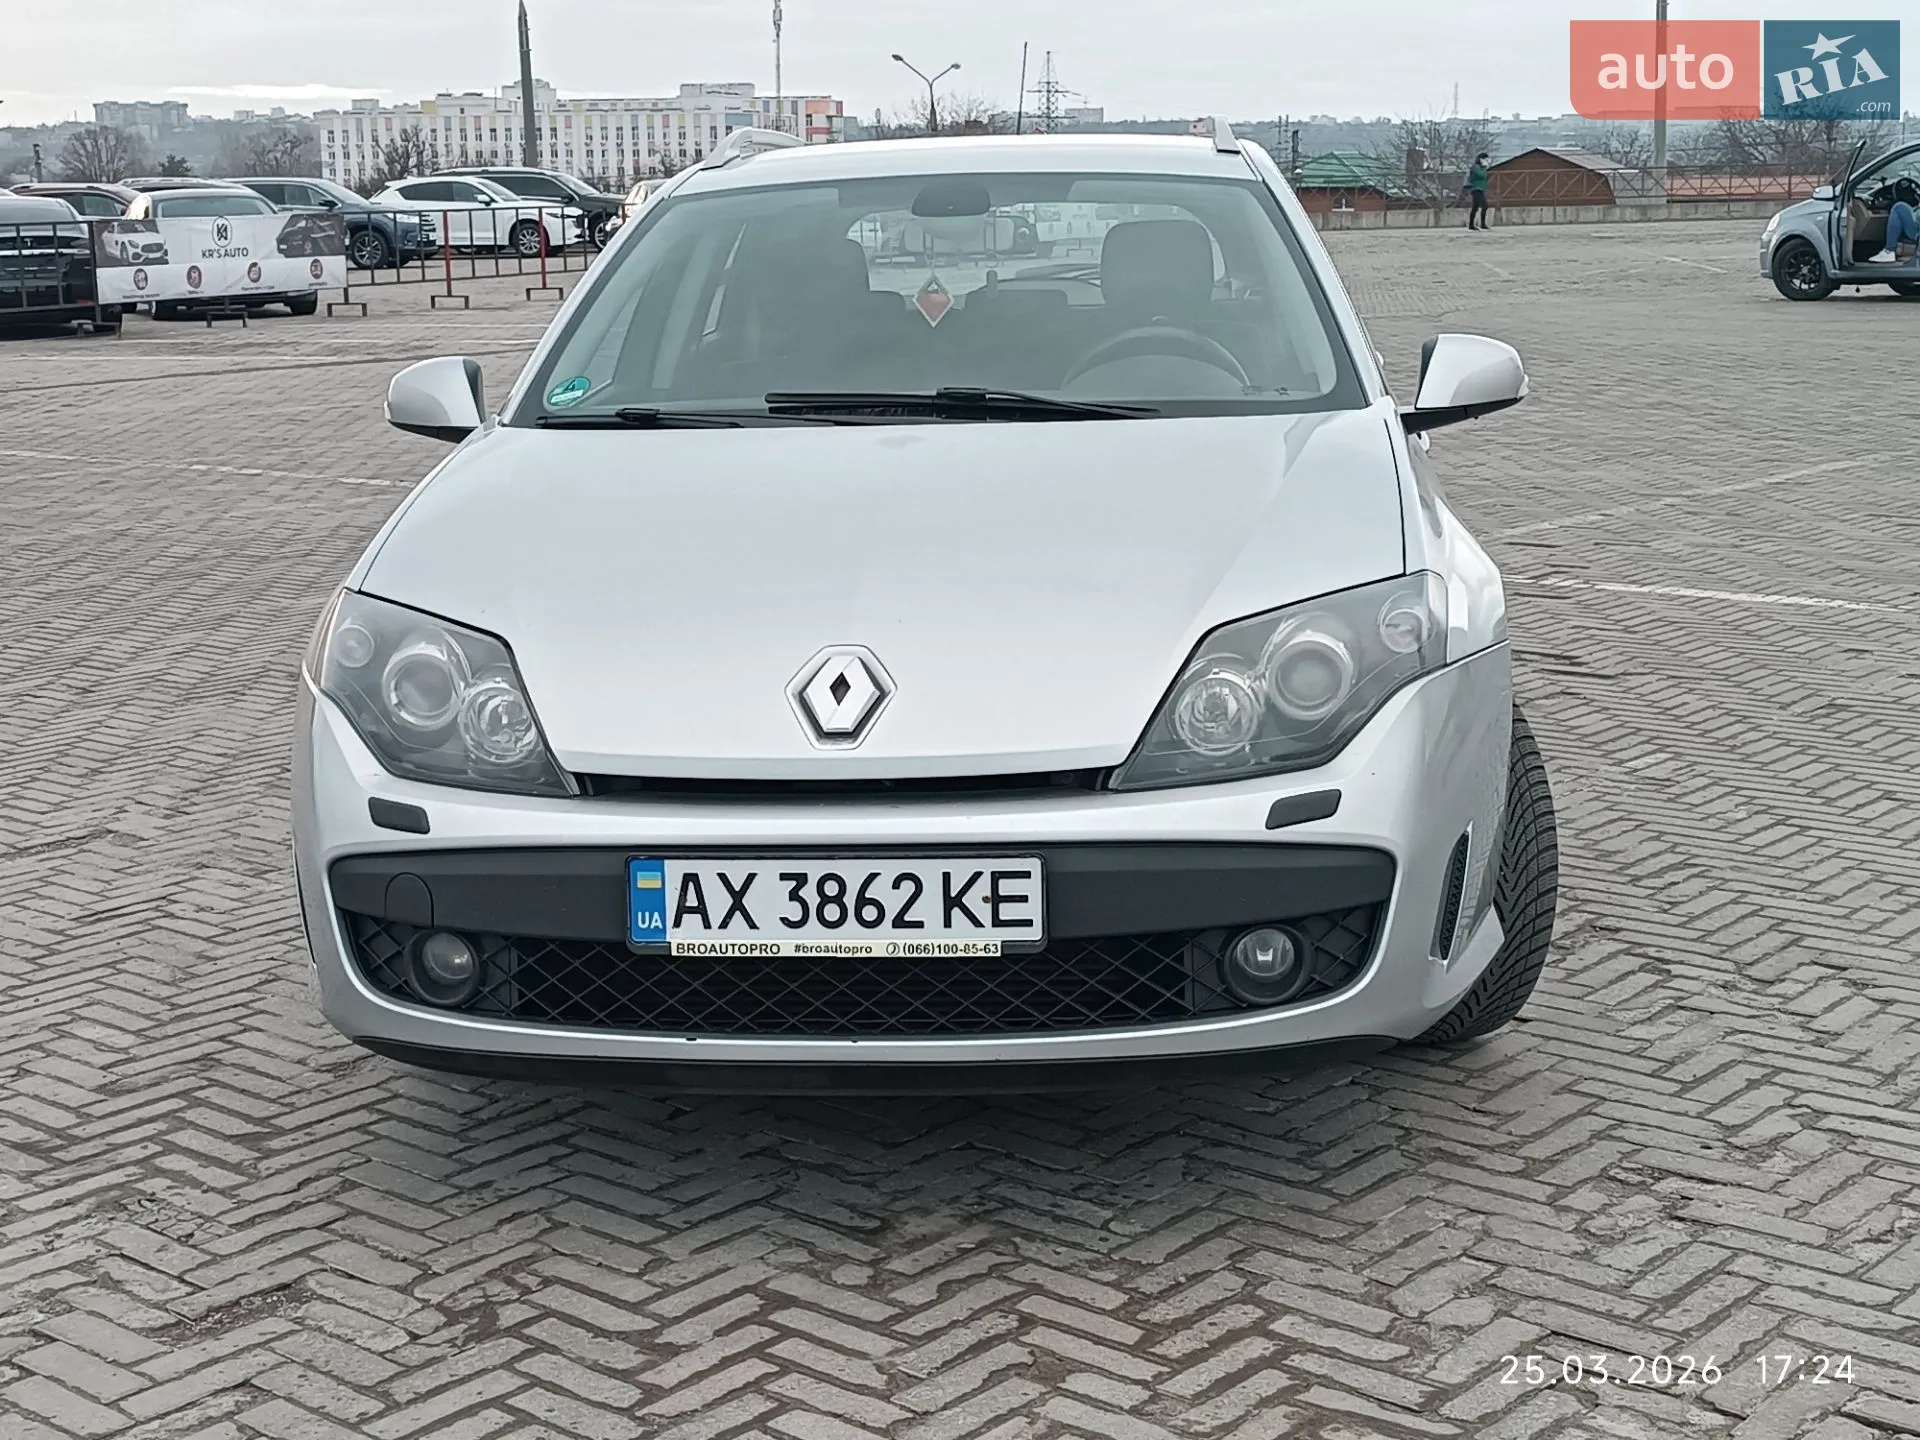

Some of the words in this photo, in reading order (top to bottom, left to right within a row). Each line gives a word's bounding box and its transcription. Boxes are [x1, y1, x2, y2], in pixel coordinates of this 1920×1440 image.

[201, 248, 222, 259] KR'S
[223, 247, 249, 258] AUTO
[672, 872, 760, 930] AX
[778, 872, 925, 930] 3862
[942, 870, 1034, 929] KE
[637, 911, 663, 929] UA
[676, 943, 781, 955] BROAUTOPRO
[793, 942, 873, 956] #broautopro
[902, 942, 999, 956] (066)100-85-63
